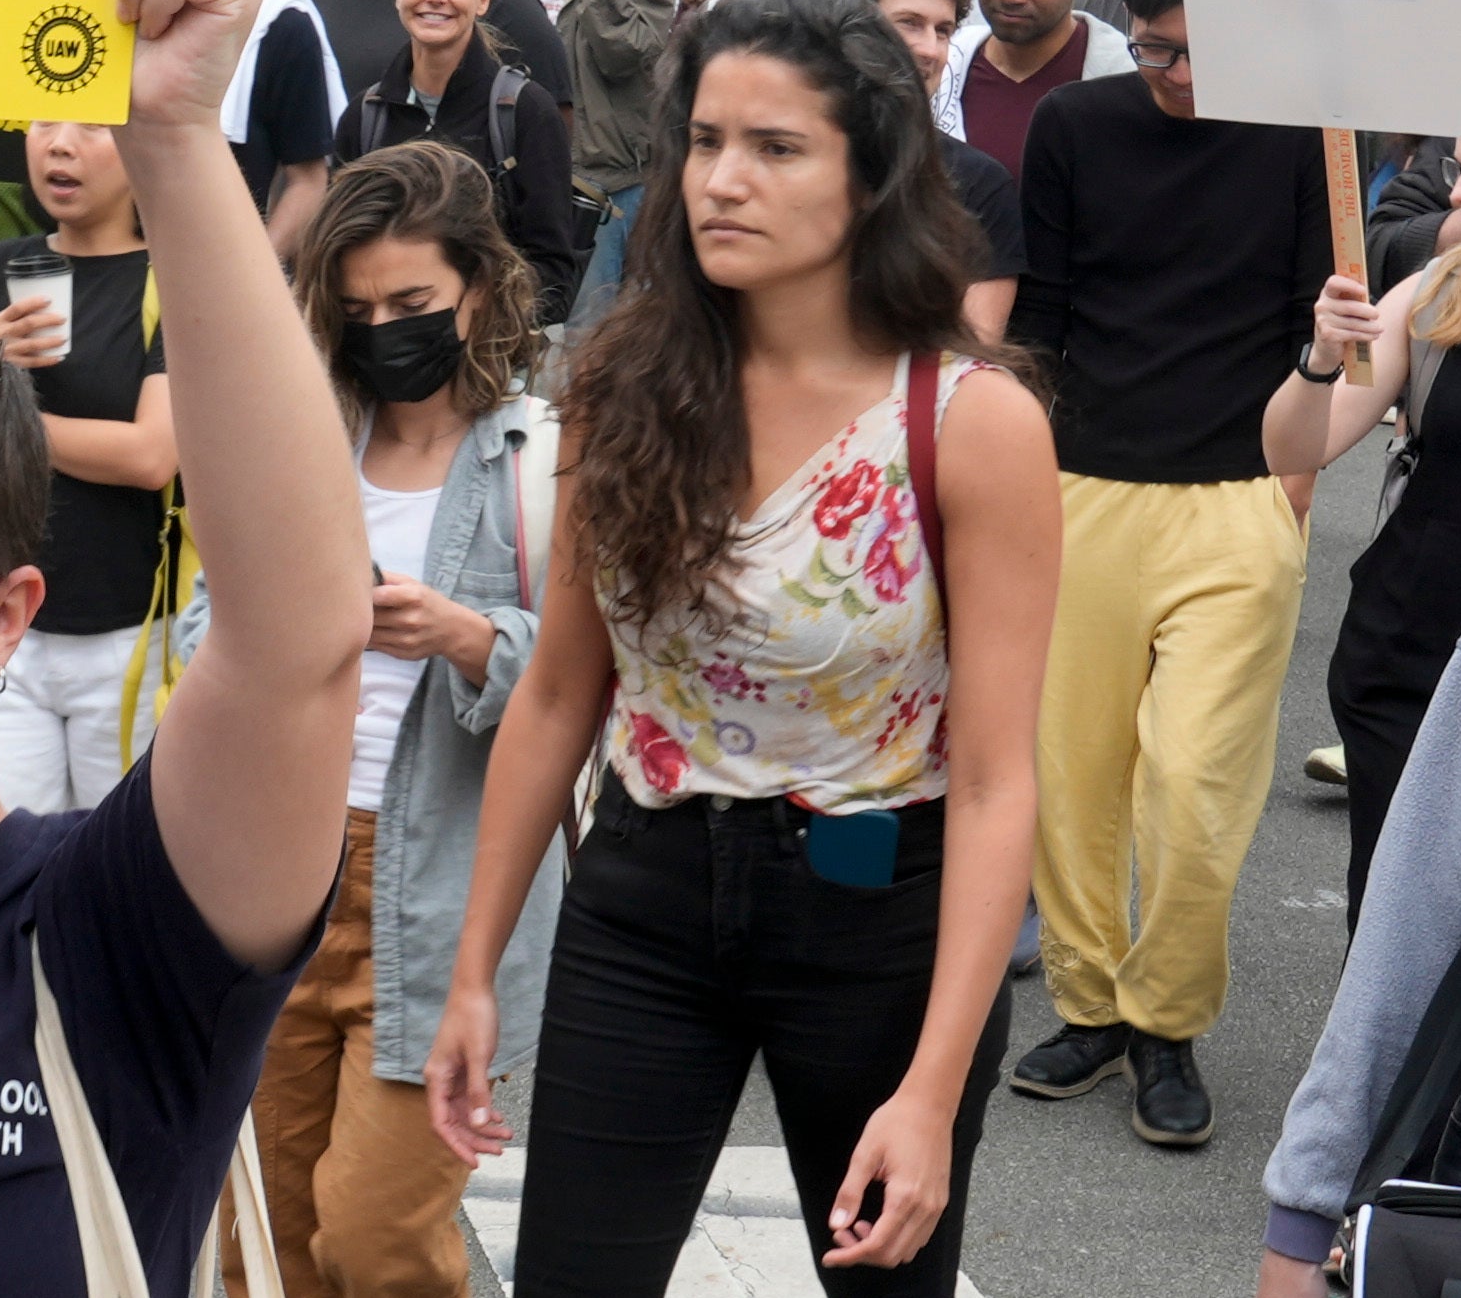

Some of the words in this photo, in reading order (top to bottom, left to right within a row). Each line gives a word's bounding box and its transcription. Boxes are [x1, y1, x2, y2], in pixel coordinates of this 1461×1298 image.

[45, 39, 81, 58] UAW
[1341, 153, 1355, 190] HOME
[1344, 194, 1356, 217] THE
